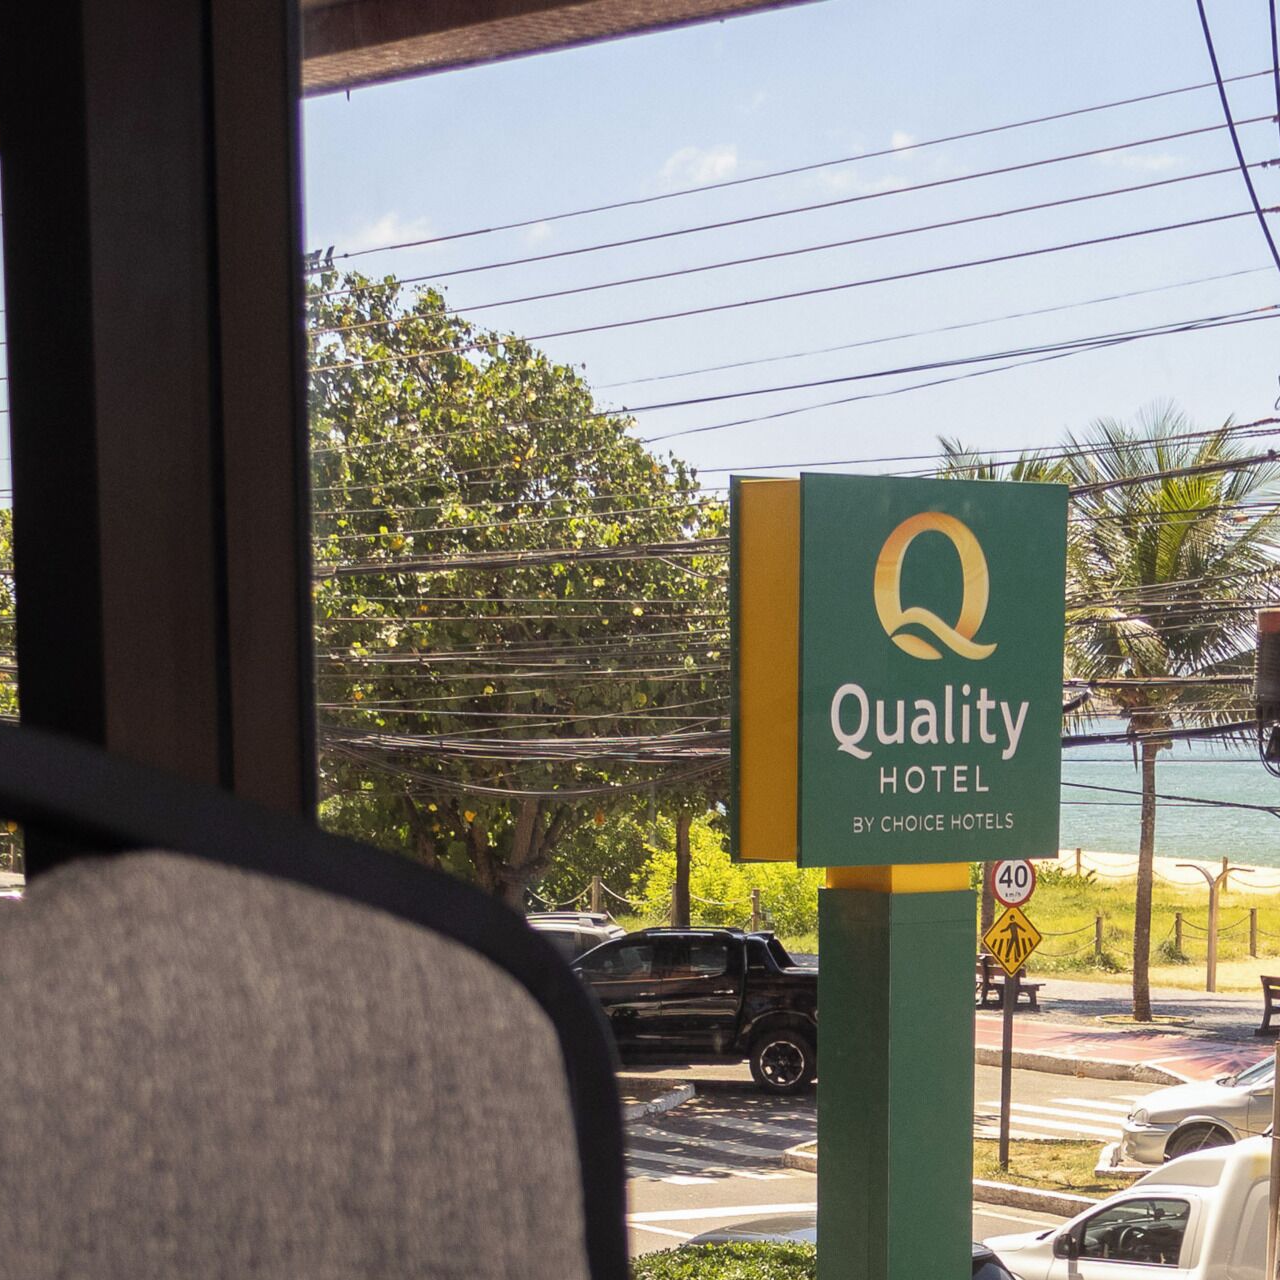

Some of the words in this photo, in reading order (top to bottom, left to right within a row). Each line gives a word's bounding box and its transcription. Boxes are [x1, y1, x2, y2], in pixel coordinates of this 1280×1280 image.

[874, 512, 998, 661] Q
[831, 683, 1029, 760] Quality
[879, 765, 989, 794] HOTEL
[853, 816, 875, 833] BY
[881, 814, 945, 832] CHOICE
[951, 812, 1014, 830] HOTELS
[999, 865, 1028, 888] 40
